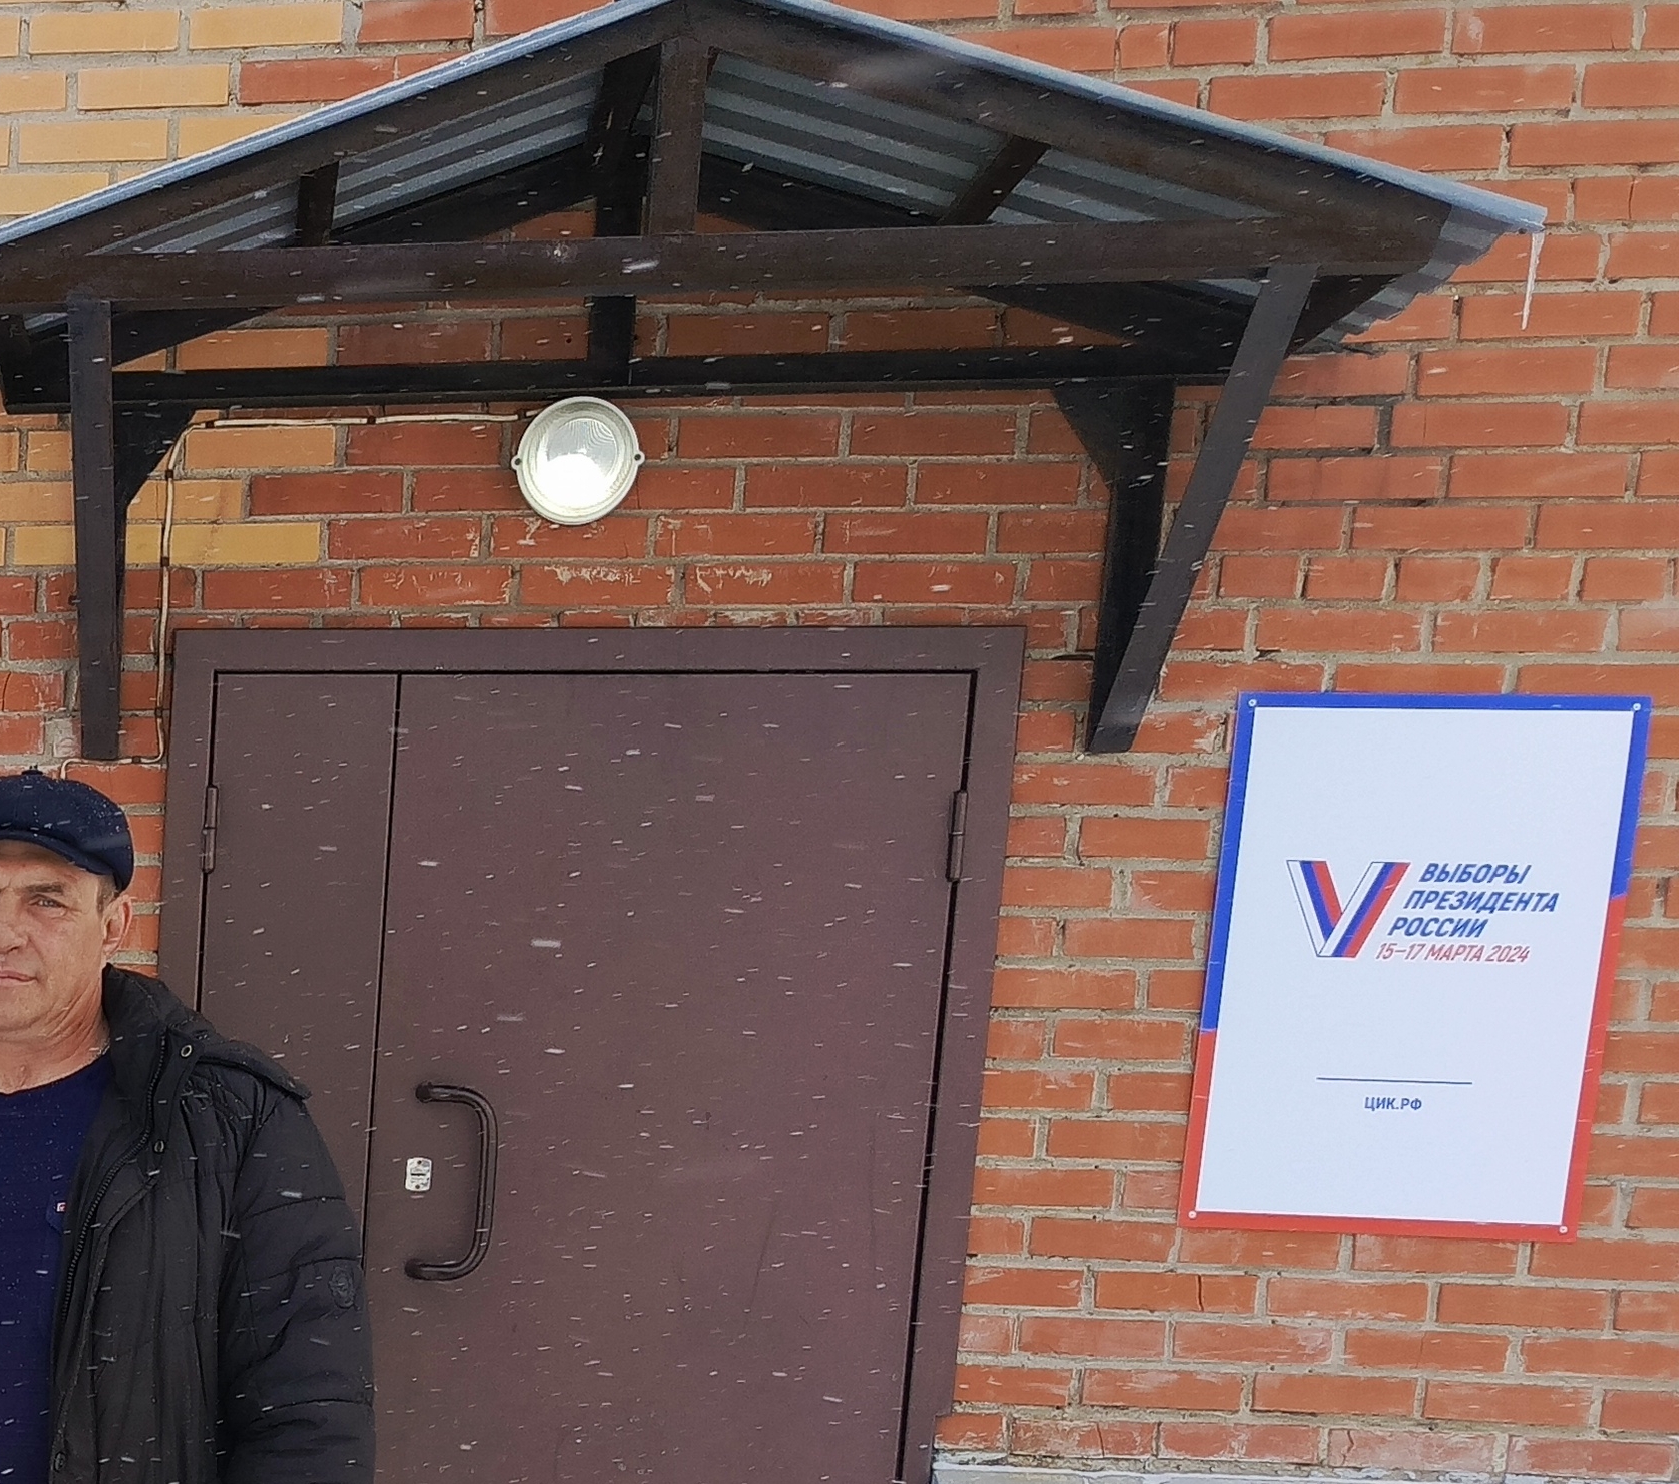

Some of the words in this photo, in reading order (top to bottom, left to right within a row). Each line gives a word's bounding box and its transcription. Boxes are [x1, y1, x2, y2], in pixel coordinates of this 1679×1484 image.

[1418, 863, 1532, 884] ВЫБОРЫ
[1403, 890, 1560, 914] ПРЕЗИДЕНТА
[1387, 917, 1489, 938] РОССИИ
[1428, 944, 1485, 962] МАРТА
[1485, 946, 1531, 963] 2024
[1364, 1096, 1422, 1111] ЦИК.РФ
